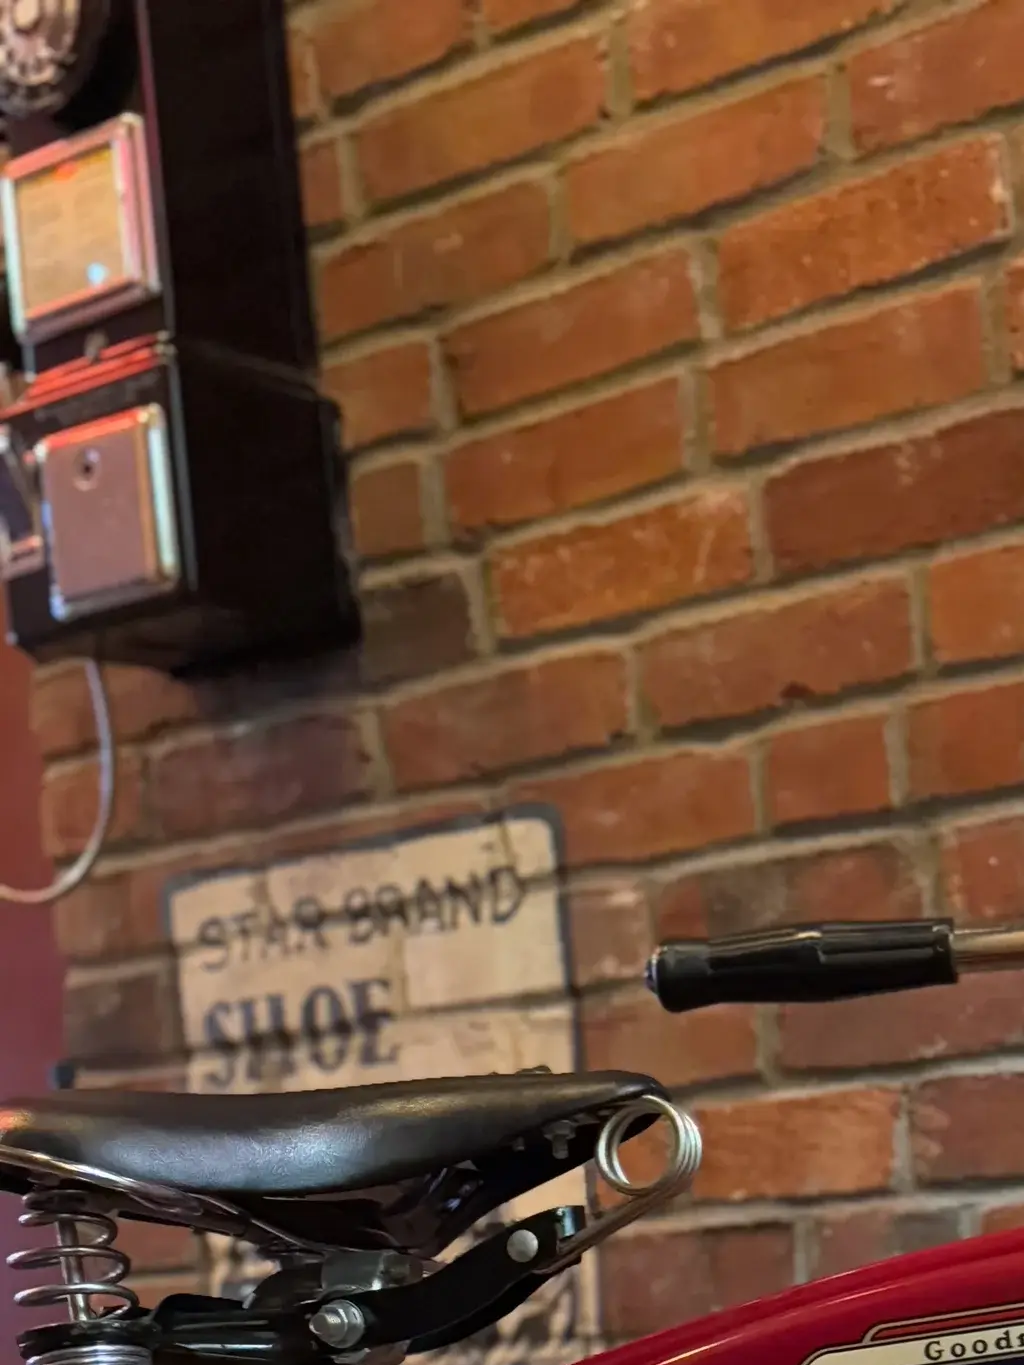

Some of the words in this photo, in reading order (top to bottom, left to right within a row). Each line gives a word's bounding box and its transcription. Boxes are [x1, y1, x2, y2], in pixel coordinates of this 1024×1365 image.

[199, 896, 332, 971] STAR
[344, 867, 526, 943] BRAND
[203, 978, 400, 1087] SHOE
